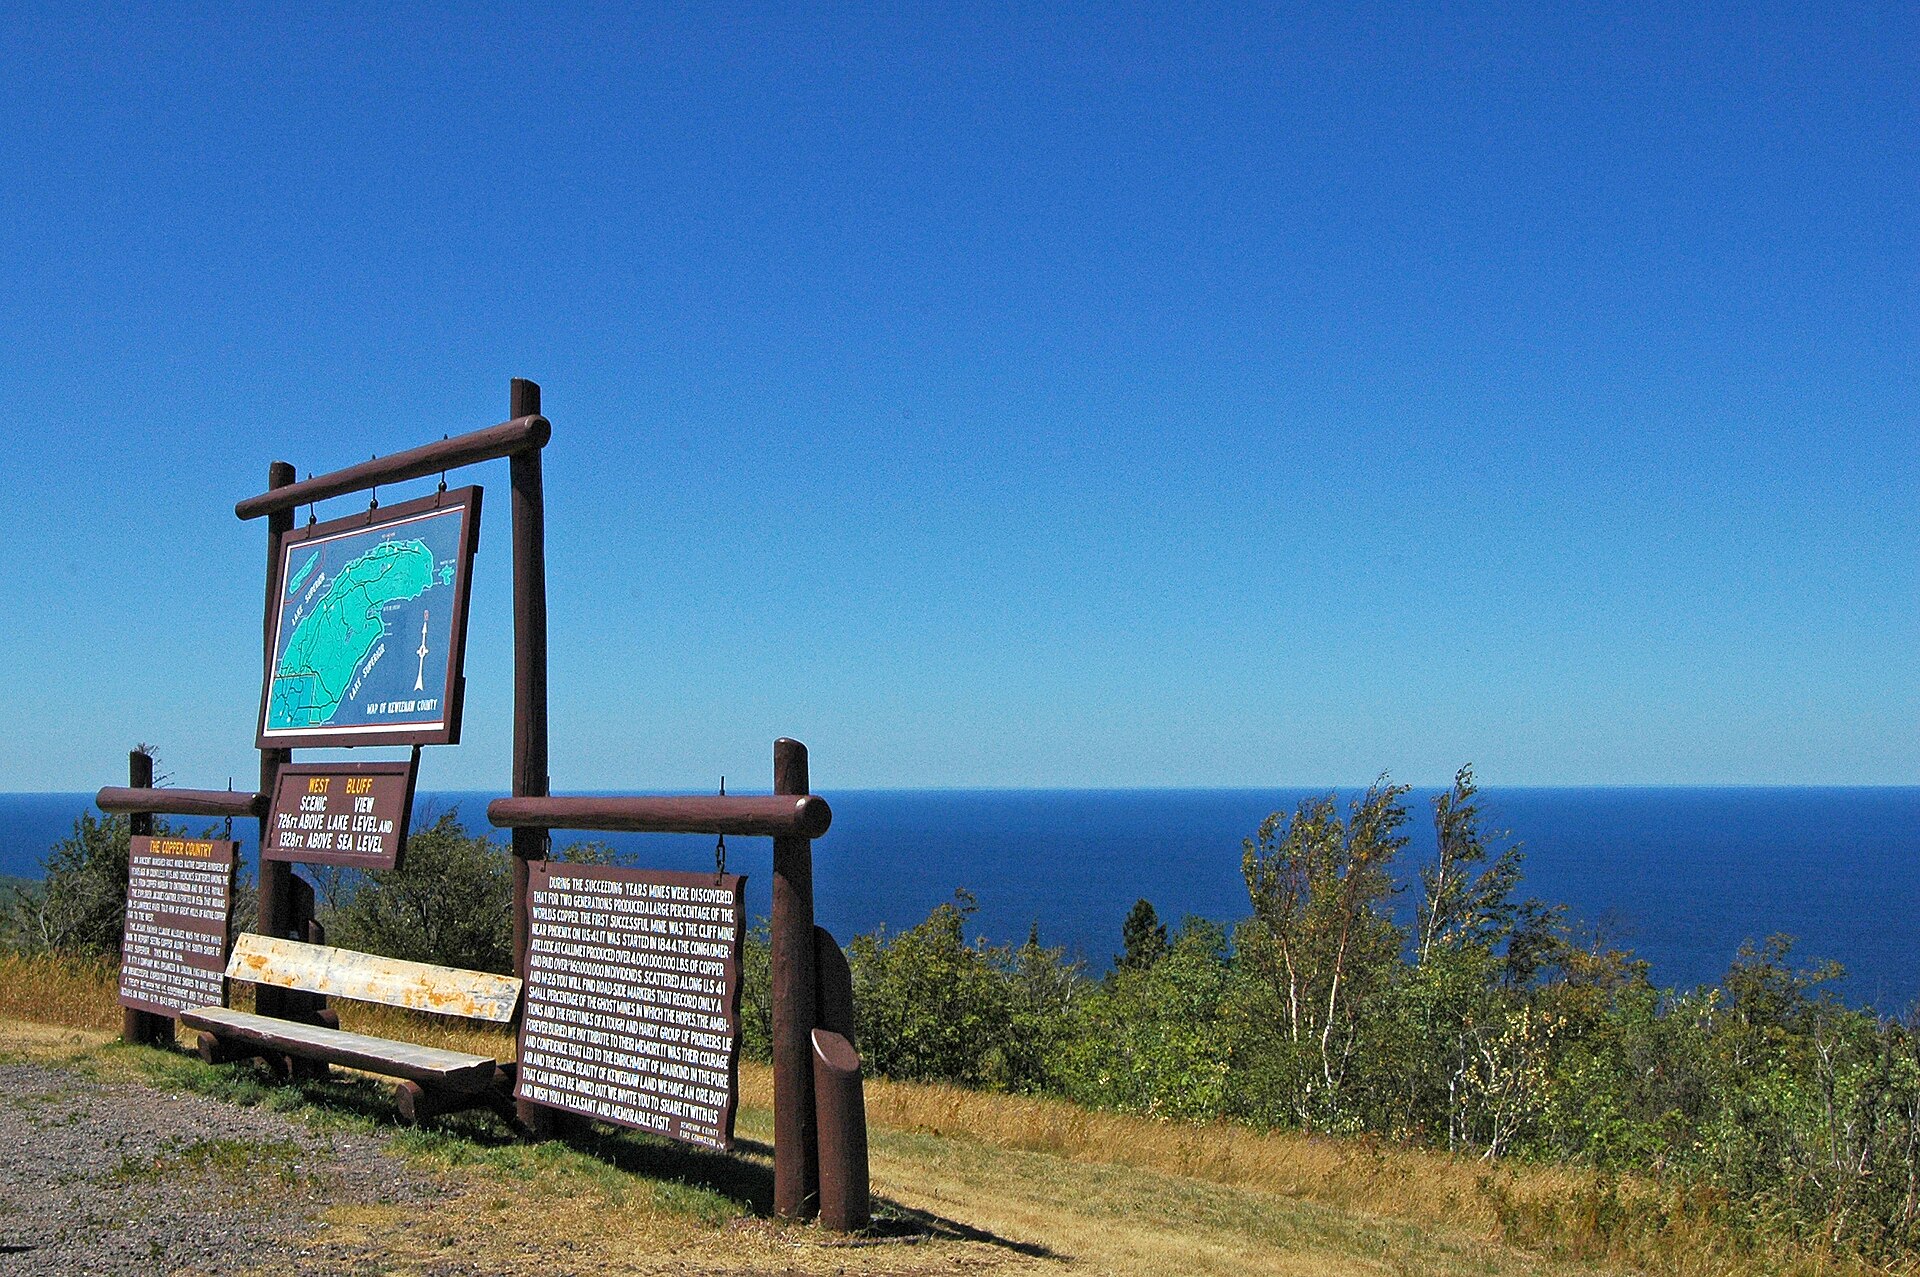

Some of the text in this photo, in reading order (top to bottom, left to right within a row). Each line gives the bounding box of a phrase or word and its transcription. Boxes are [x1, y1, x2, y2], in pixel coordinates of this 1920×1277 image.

[291, 573, 326, 626] LAKE SUPERIOR
[349, 643, 385, 700] LAKE SUPERIOR
[366, 699, 437, 714] MAP OF KEWEENAW COUNTY
[300, 796, 375, 813] SCENIC VIEW
[309, 778, 372, 794] WEST BLUFF
[299, 814, 324, 830] ABOVE
[327, 814, 349, 830] LAKE
[352, 815, 377, 832] LEVEL
[378, 820, 393, 833] AND
[307, 833, 333, 849] ABOVE
[337, 834, 352, 850] SEA
[357, 835, 382, 852] LEVEL
[150, 840, 213, 857] THE COPPER COUNTRY
[534, 891, 733, 923] THAT FOR TWO GENERATIONS PRODUCED LARGE PERCENTAGE OF THE
[549, 876, 733, 904] DURING THE SUCCEEDING YEARS MINES WERE DISCOVERED
[532, 923, 546, 937] NEAR
[548, 924, 571, 940] PHOENIX
[572, 927, 580, 941] ON
[607, 931, 620, 945] WAS
[622, 933, 649, 949] STARTED
[678, 940, 689, 954] THE
[557, 909, 734, 941] COPPER THE FIRST SUCCESSFUL MINE WAS THE CLIFF MINE
[531, 954, 726, 996] AND PAID OVER SCATTERED ALONG 41
[561, 942, 586, 958] CALUMET
[586, 946, 615, 962] PRODUCED
[616, 949, 630, 964] OVER
[690, 959, 698, 973] OF
[700, 960, 724, 977] COPPER
[529, 970, 540, 983] AND
[557, 974, 567, 988] YOU
[568, 976, 581, 990] WILL
[582, 978, 595, 992] FIND
[627, 985, 656, 1002] MARKERS
[657, 990, 671, 1005] THAT
[673, 992, 697, 1009] RECORD
[698, 996, 716, 1012] ONLY
[529, 985, 546, 1001] SMALL
[547, 988, 578, 1006] PERCENTAGE
[580, 994, 586, 1007] OF
[587, 995, 596, 1009] THE
[597, 997, 616, 1012] GHOST
[617, 1000, 635, 1016] MINES
[636, 1003, 642, 1017] IN
[643, 1004, 663, 1020] WHICH
[664, 1007, 675, 1022] THE
[697, 1013, 708, 1028] THE
[526, 1017, 728, 1070] FOREVER WE PAY TRIBUTE TO WAS COURAGE
[528, 1002, 543, 1016] TIONS
[544, 1005, 555, 1018] AND
[556, 1007, 566, 1020] THE
[566, 1009, 594, 1026] FORTUNES
[595, 1014, 601, 1027] OF
[606, 1016, 625, 1032] TOUGH
[626, 1019, 638, 1034] AND
[639, 1022, 659, 1038] HARDY
[660, 1025, 680, 1042] GROUP
[682, 1029, 690, 1044] OF
[691, 1031, 721, 1050] PIONEERS
[524, 1050, 728, 1108] AIR AND THE SCENIC BEAUTY OF KEWEENAW LAND WE HAVE ORE BODY
[525, 1034, 728, 1089] AND CONFIDENCE THAT LED TO THE ENRICHMENT OF MANKIND IN THE PURE
[520, 1082, 533, 1099] AND
[534, 1085, 548, 1102] WISH
[549, 1089, 560, 1105] YOU
[566, 1093, 596, 1114] PLEASANT
[597, 1100, 610, 1117] AND
[612, 1104, 651, 1127] MEMORABLE
[523, 1066, 536, 1082] THAT
[537, 1070, 548, 1085] CAN
[549, 1072, 566, 1089] NEVER
[567, 1076, 575, 1091] BE
[576, 1078, 594, 1096] MINED
[608, 1086, 617, 1101] WE
[618, 1088, 637, 1106] INVITE
[638, 1092, 650, 1109] YOU
[651, 1095, 659, 1111] TO
[660, 1097, 682, 1117] SHARE
[683, 1103, 690, 1118] IT
[690, 1104, 707, 1122] WITH
[708, 1108, 718, 1125] US
